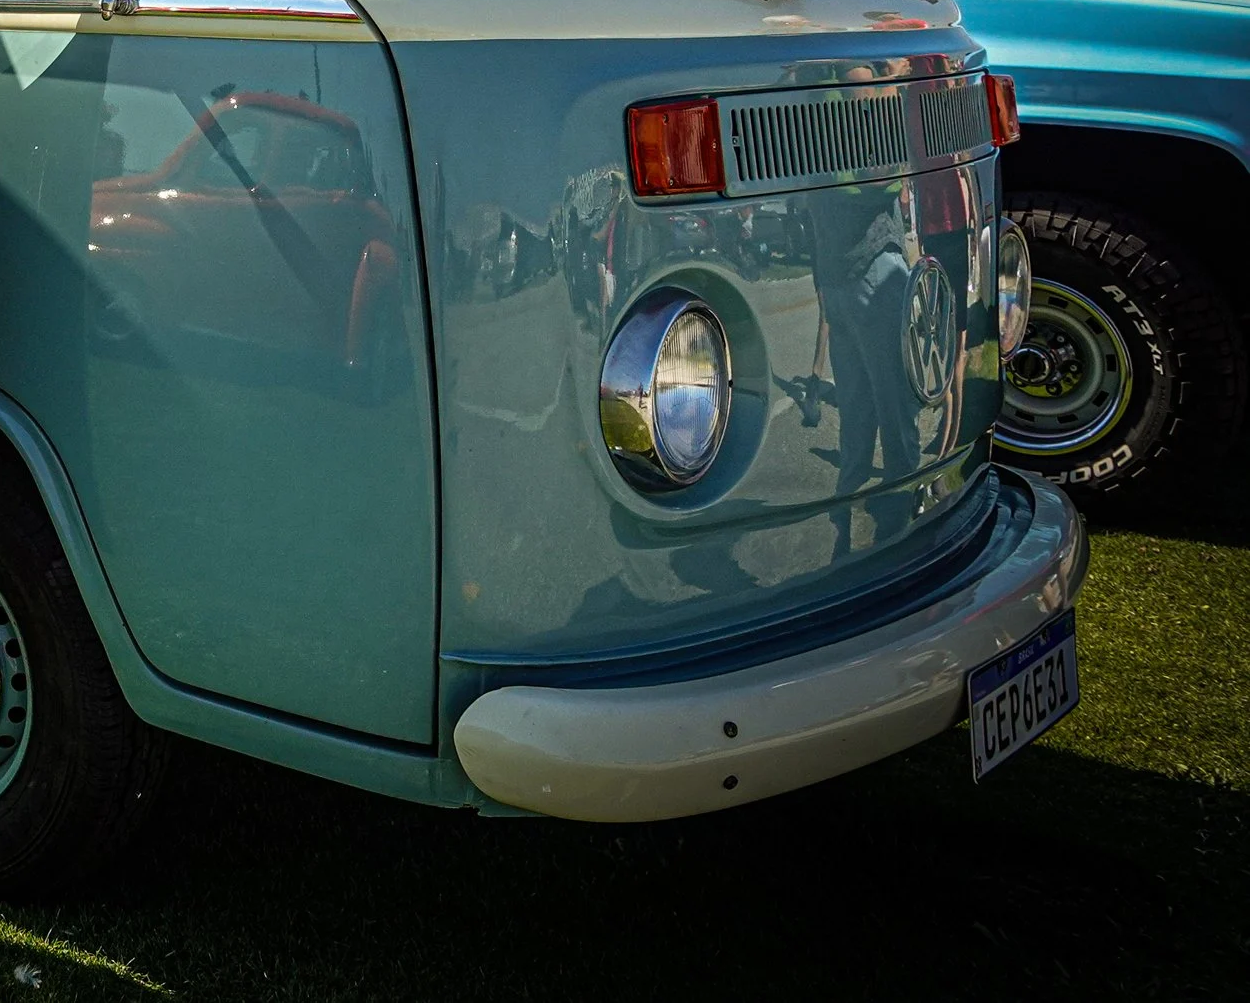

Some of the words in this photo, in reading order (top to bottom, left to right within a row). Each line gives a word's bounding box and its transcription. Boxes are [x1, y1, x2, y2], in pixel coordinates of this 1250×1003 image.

[1101, 285, 1154, 335] AT3
[1146, 340, 1164, 375] XLT
[1020, 444, 1132, 484] COOP
[982, 649, 1069, 760] CEP6E31
